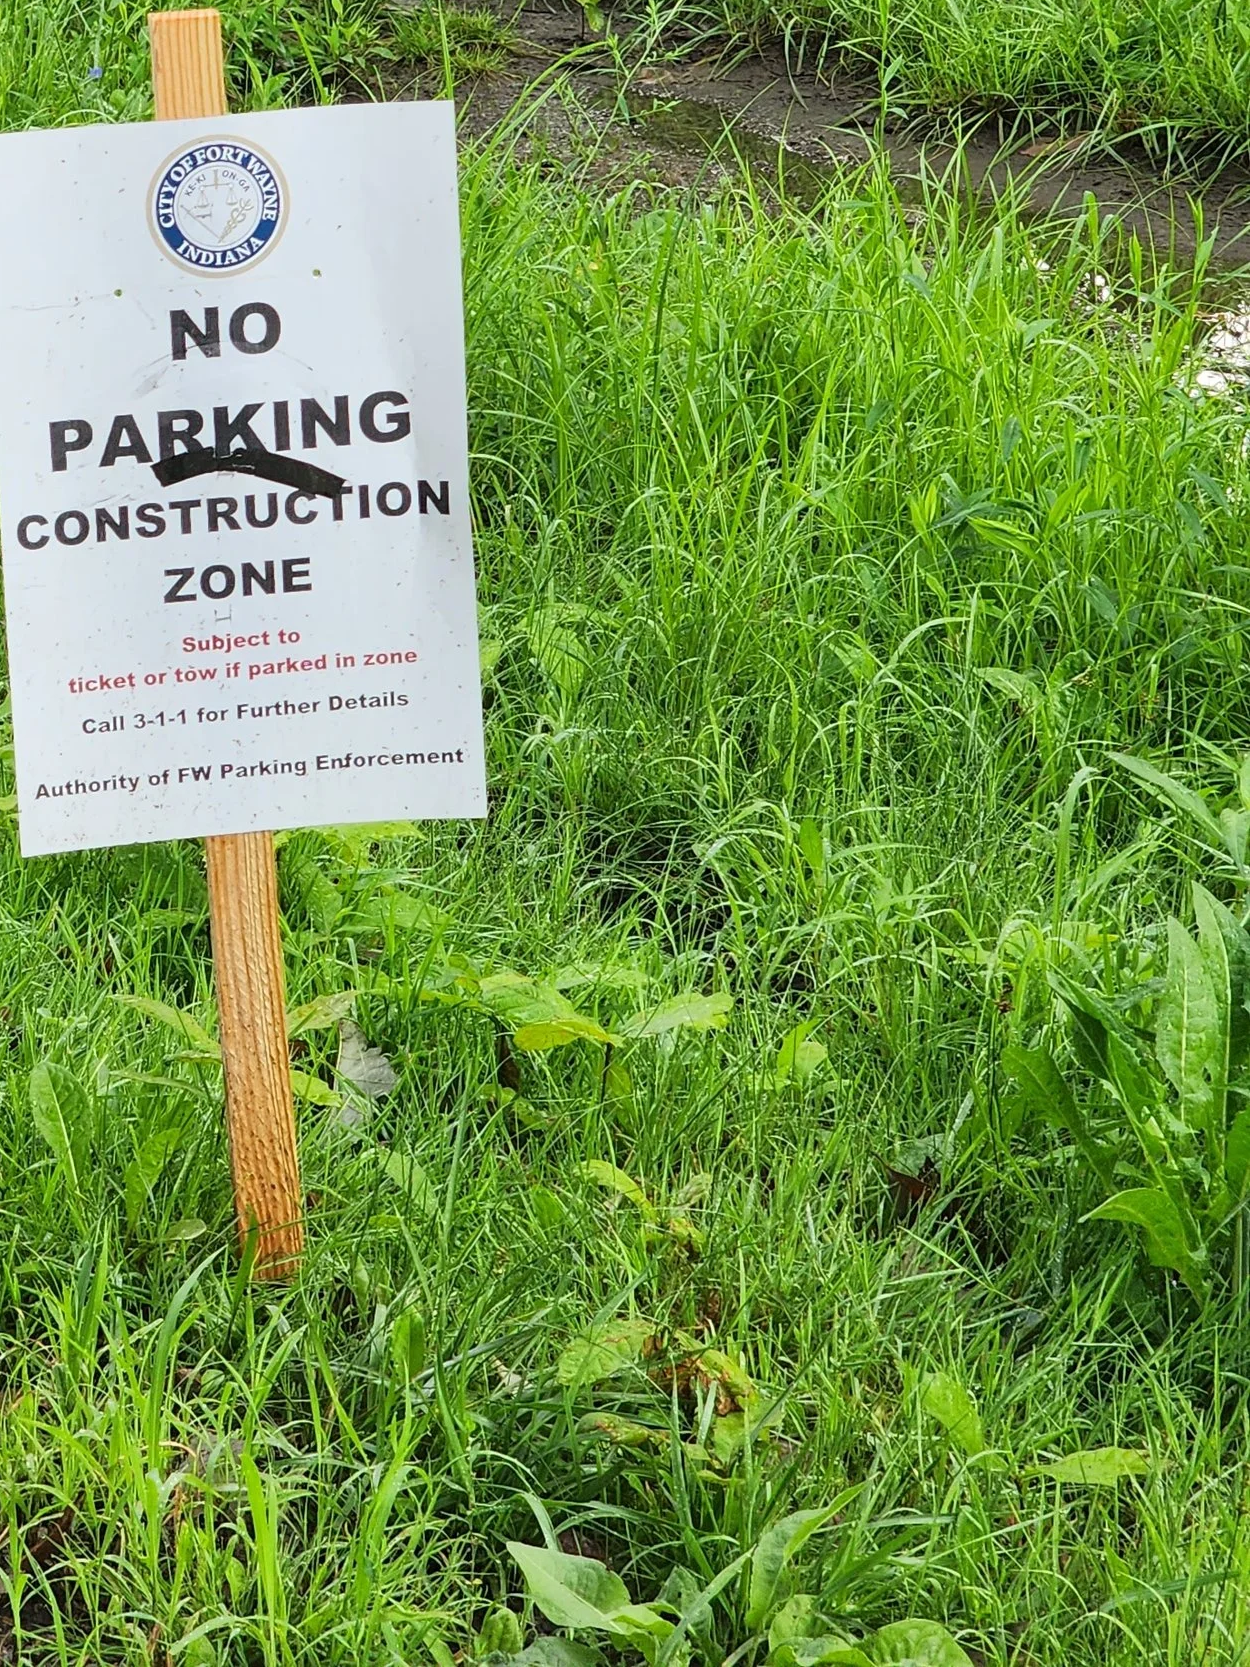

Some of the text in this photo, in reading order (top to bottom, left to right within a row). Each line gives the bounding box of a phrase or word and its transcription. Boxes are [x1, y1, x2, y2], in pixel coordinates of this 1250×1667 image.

[158, 146, 278, 228] CITY OF FORT WAYNE
[184, 169, 251, 197] KE-KI ON-GA
[176, 237, 265, 266] INDIANA
[170, 302, 281, 361] NO
[49, 391, 410, 472] PARKING
[17, 480, 450, 550] CONSTRUCTION
[164, 557, 312, 603] ZONE
[182, 628, 301, 655] Subject to
[68, 651, 418, 694] ticket or tow if parked in zone
[81, 690, 409, 735] Call 3-1-1 for Further Details
[35, 748, 464, 800] Authority of FW Parking Enforcement
